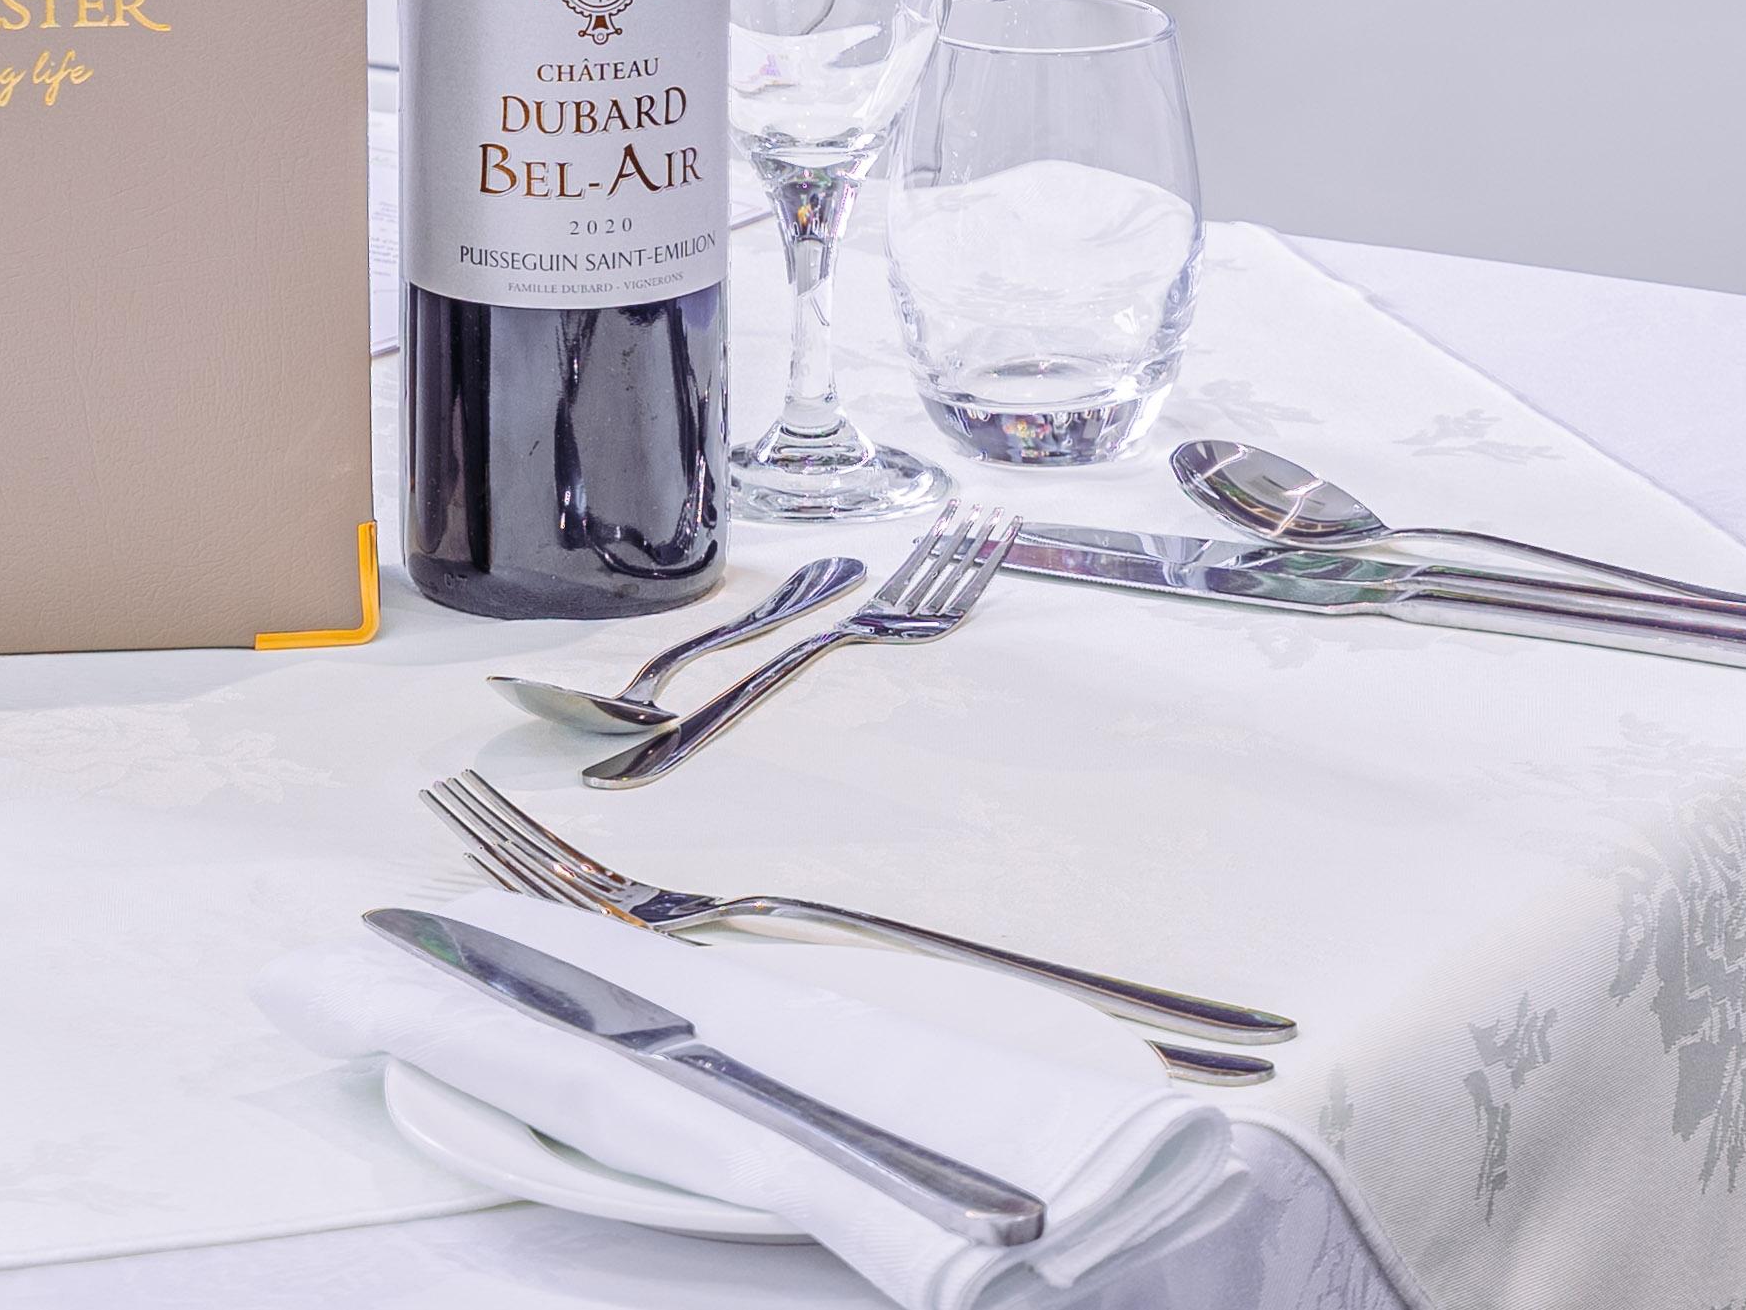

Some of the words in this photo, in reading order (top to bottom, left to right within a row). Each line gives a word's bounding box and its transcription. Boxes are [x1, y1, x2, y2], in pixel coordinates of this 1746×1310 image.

[32, 49, 94, 106] life
[536, 57, 660, 83] CHÂTEAU
[501, 85, 689, 135] DUBARD
[569, 217, 633, 235] 2020
[459, 244, 579, 272] PUISSEGUIN
[585, 231, 717, 272] SAINT-EMILION
[507, 282, 558, 294] FAMILLE
[562, 282, 614, 294] DUBARD
[623, 271, 684, 291] VIGNERONS
